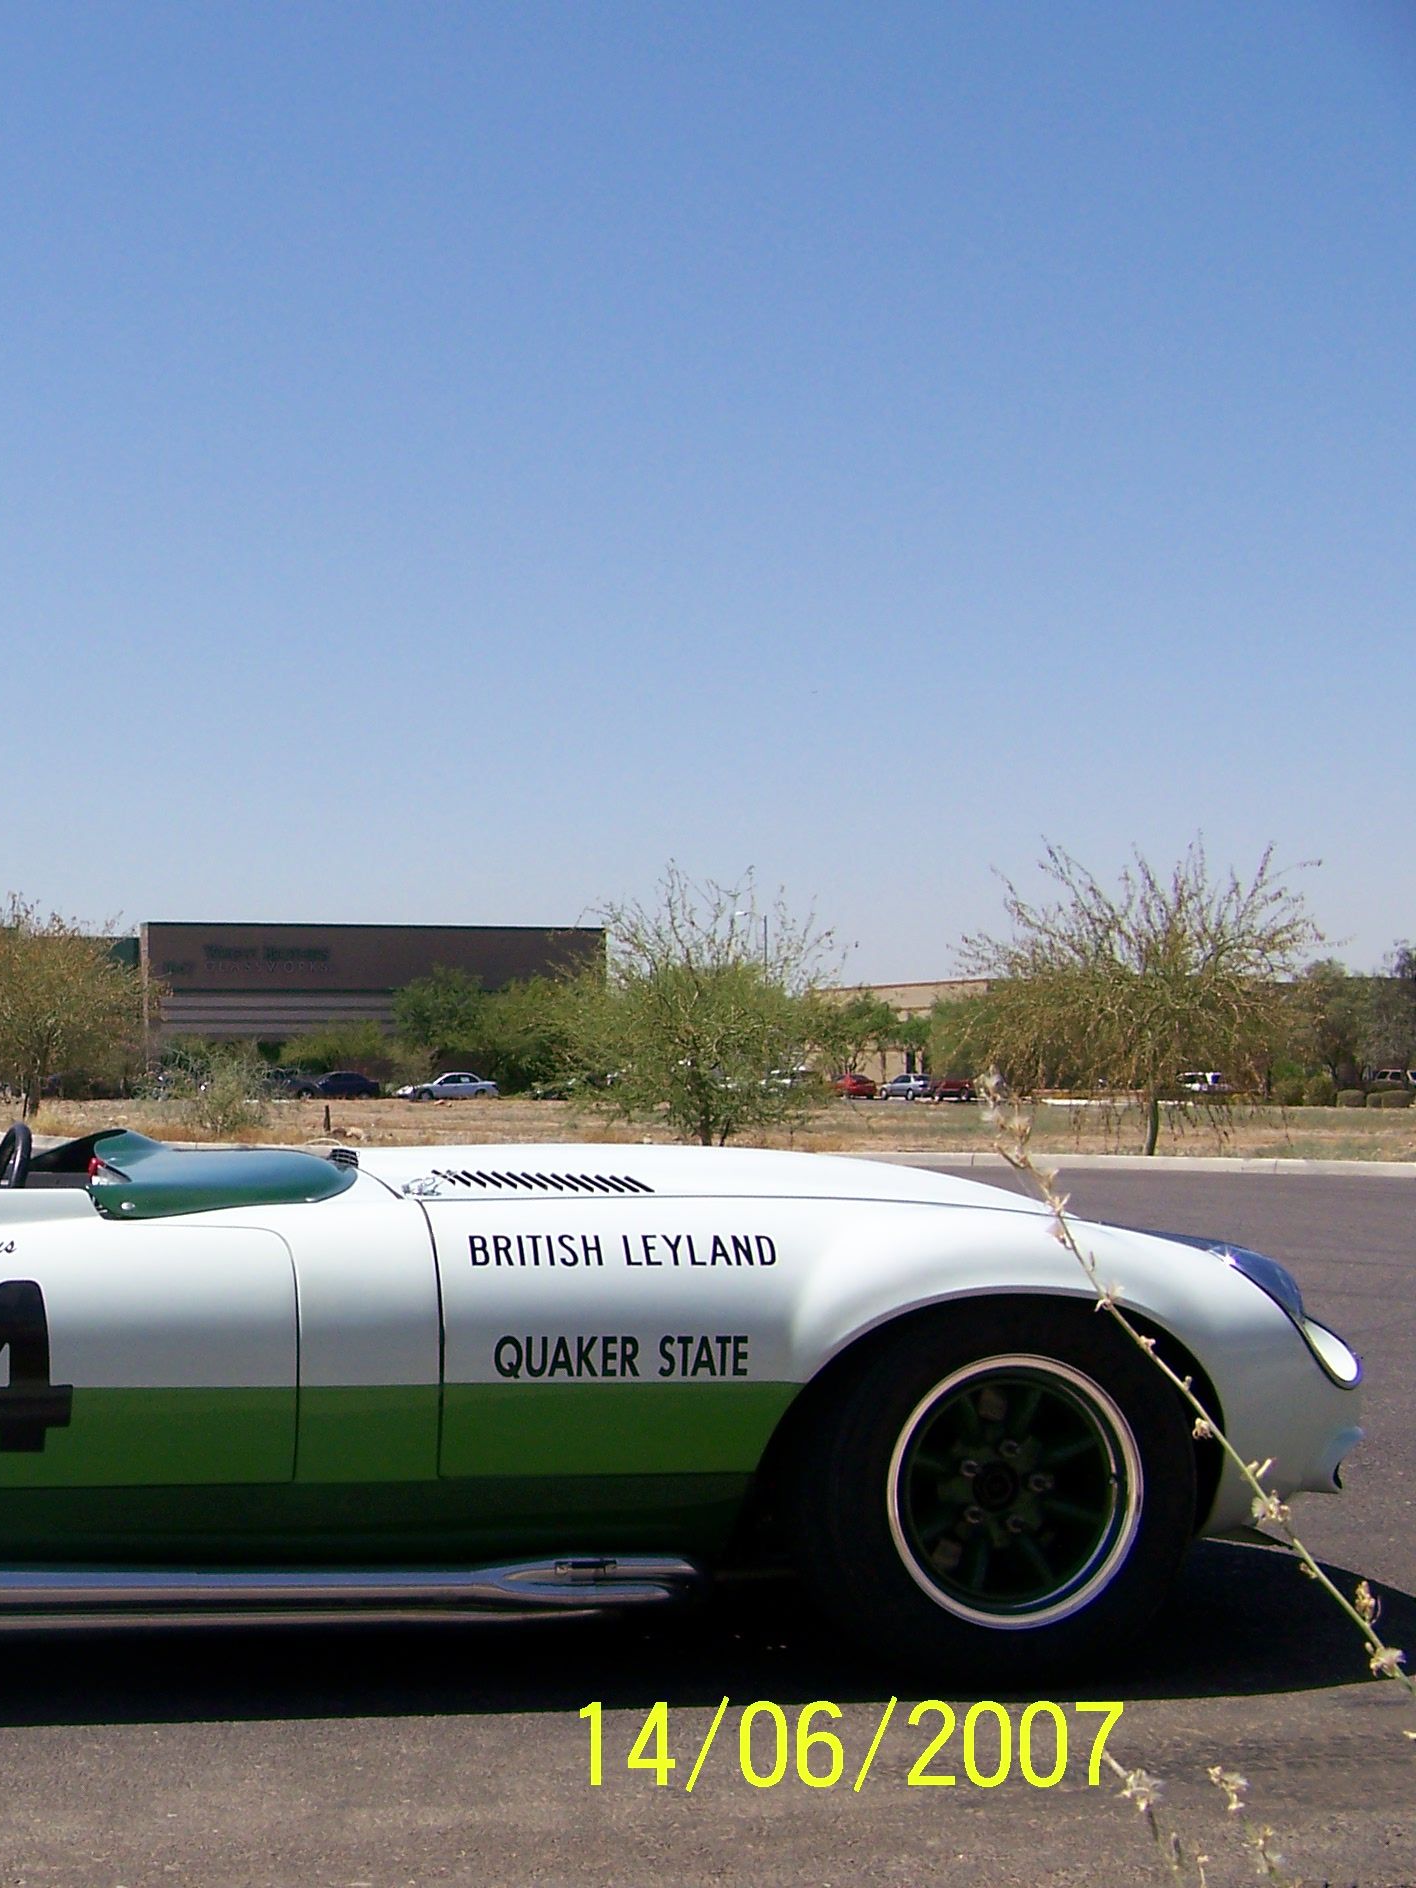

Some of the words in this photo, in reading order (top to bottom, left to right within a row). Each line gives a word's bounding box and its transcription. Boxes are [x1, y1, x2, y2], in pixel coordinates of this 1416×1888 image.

[468, 1234, 604, 1267] BRITISH
[622, 1234, 777, 1267] LEYLAND
[493, 1334, 640, 1379] QUAKER
[657, 1334, 749, 1378] STATE
